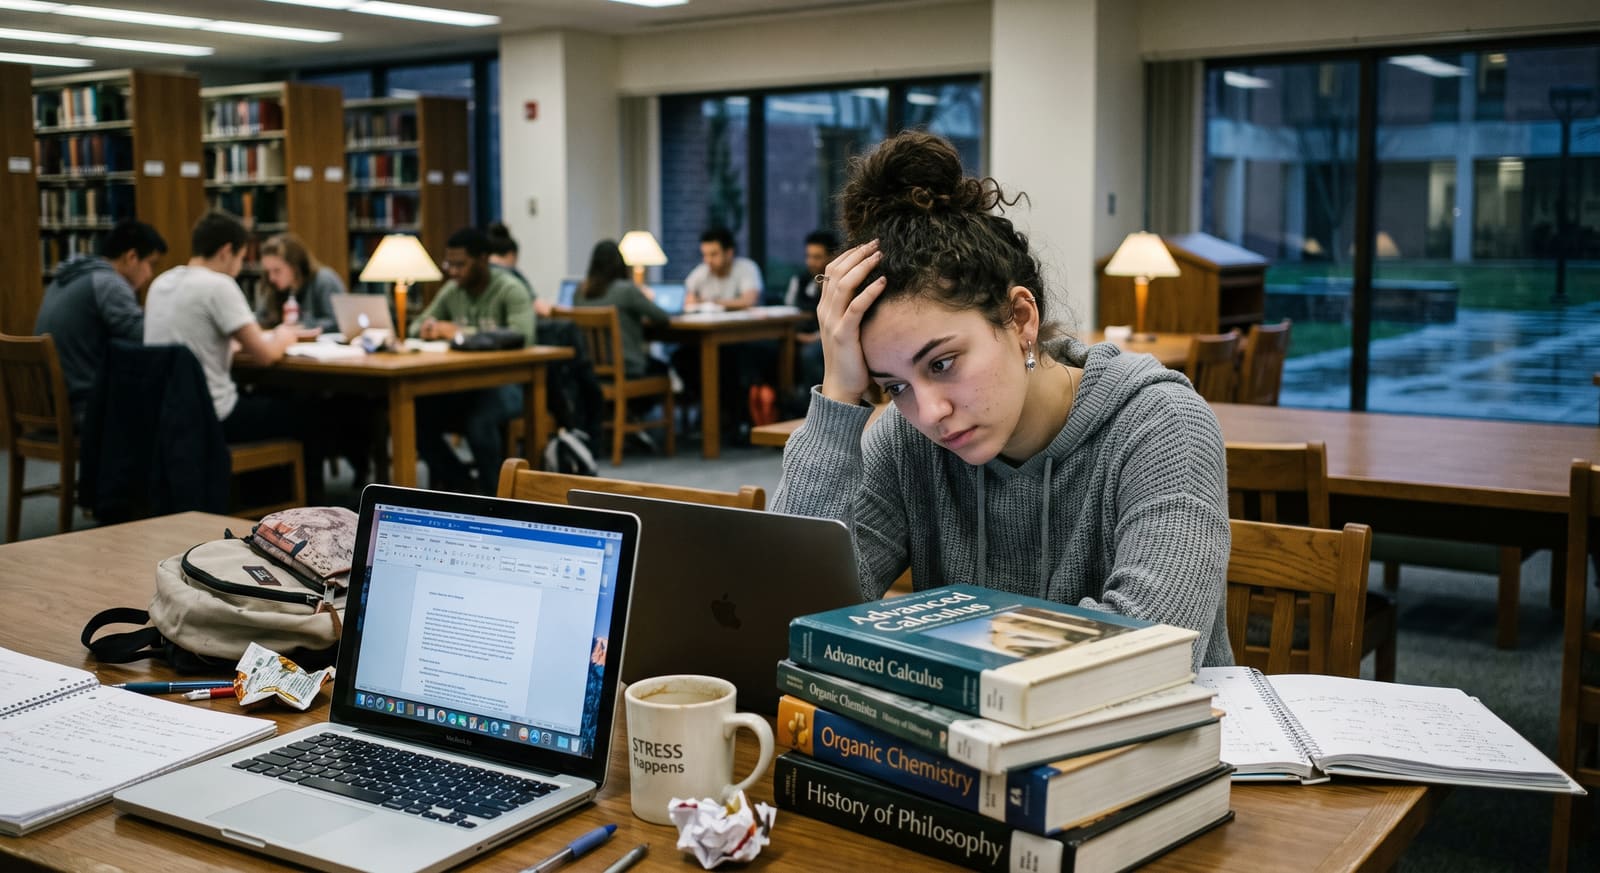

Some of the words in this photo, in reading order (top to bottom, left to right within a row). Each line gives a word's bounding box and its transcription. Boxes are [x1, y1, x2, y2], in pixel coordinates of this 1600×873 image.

[848, 592, 976, 625] Advanced
[873, 602, 991, 632] Calculus
[824, 643, 884, 674] Advanced
[887, 660, 944, 691] Calculus
[809, 682, 839, 704] Organic
[632, 736, 684, 760] STRESS
[820, 726, 882, 763] Organic
[886, 747, 974, 796] Chemistry
[632, 752, 685, 776] happens
[807, 780, 870, 824] History
[873, 803, 894, 825] of
[898, 807, 1004, 866] Philosophy
